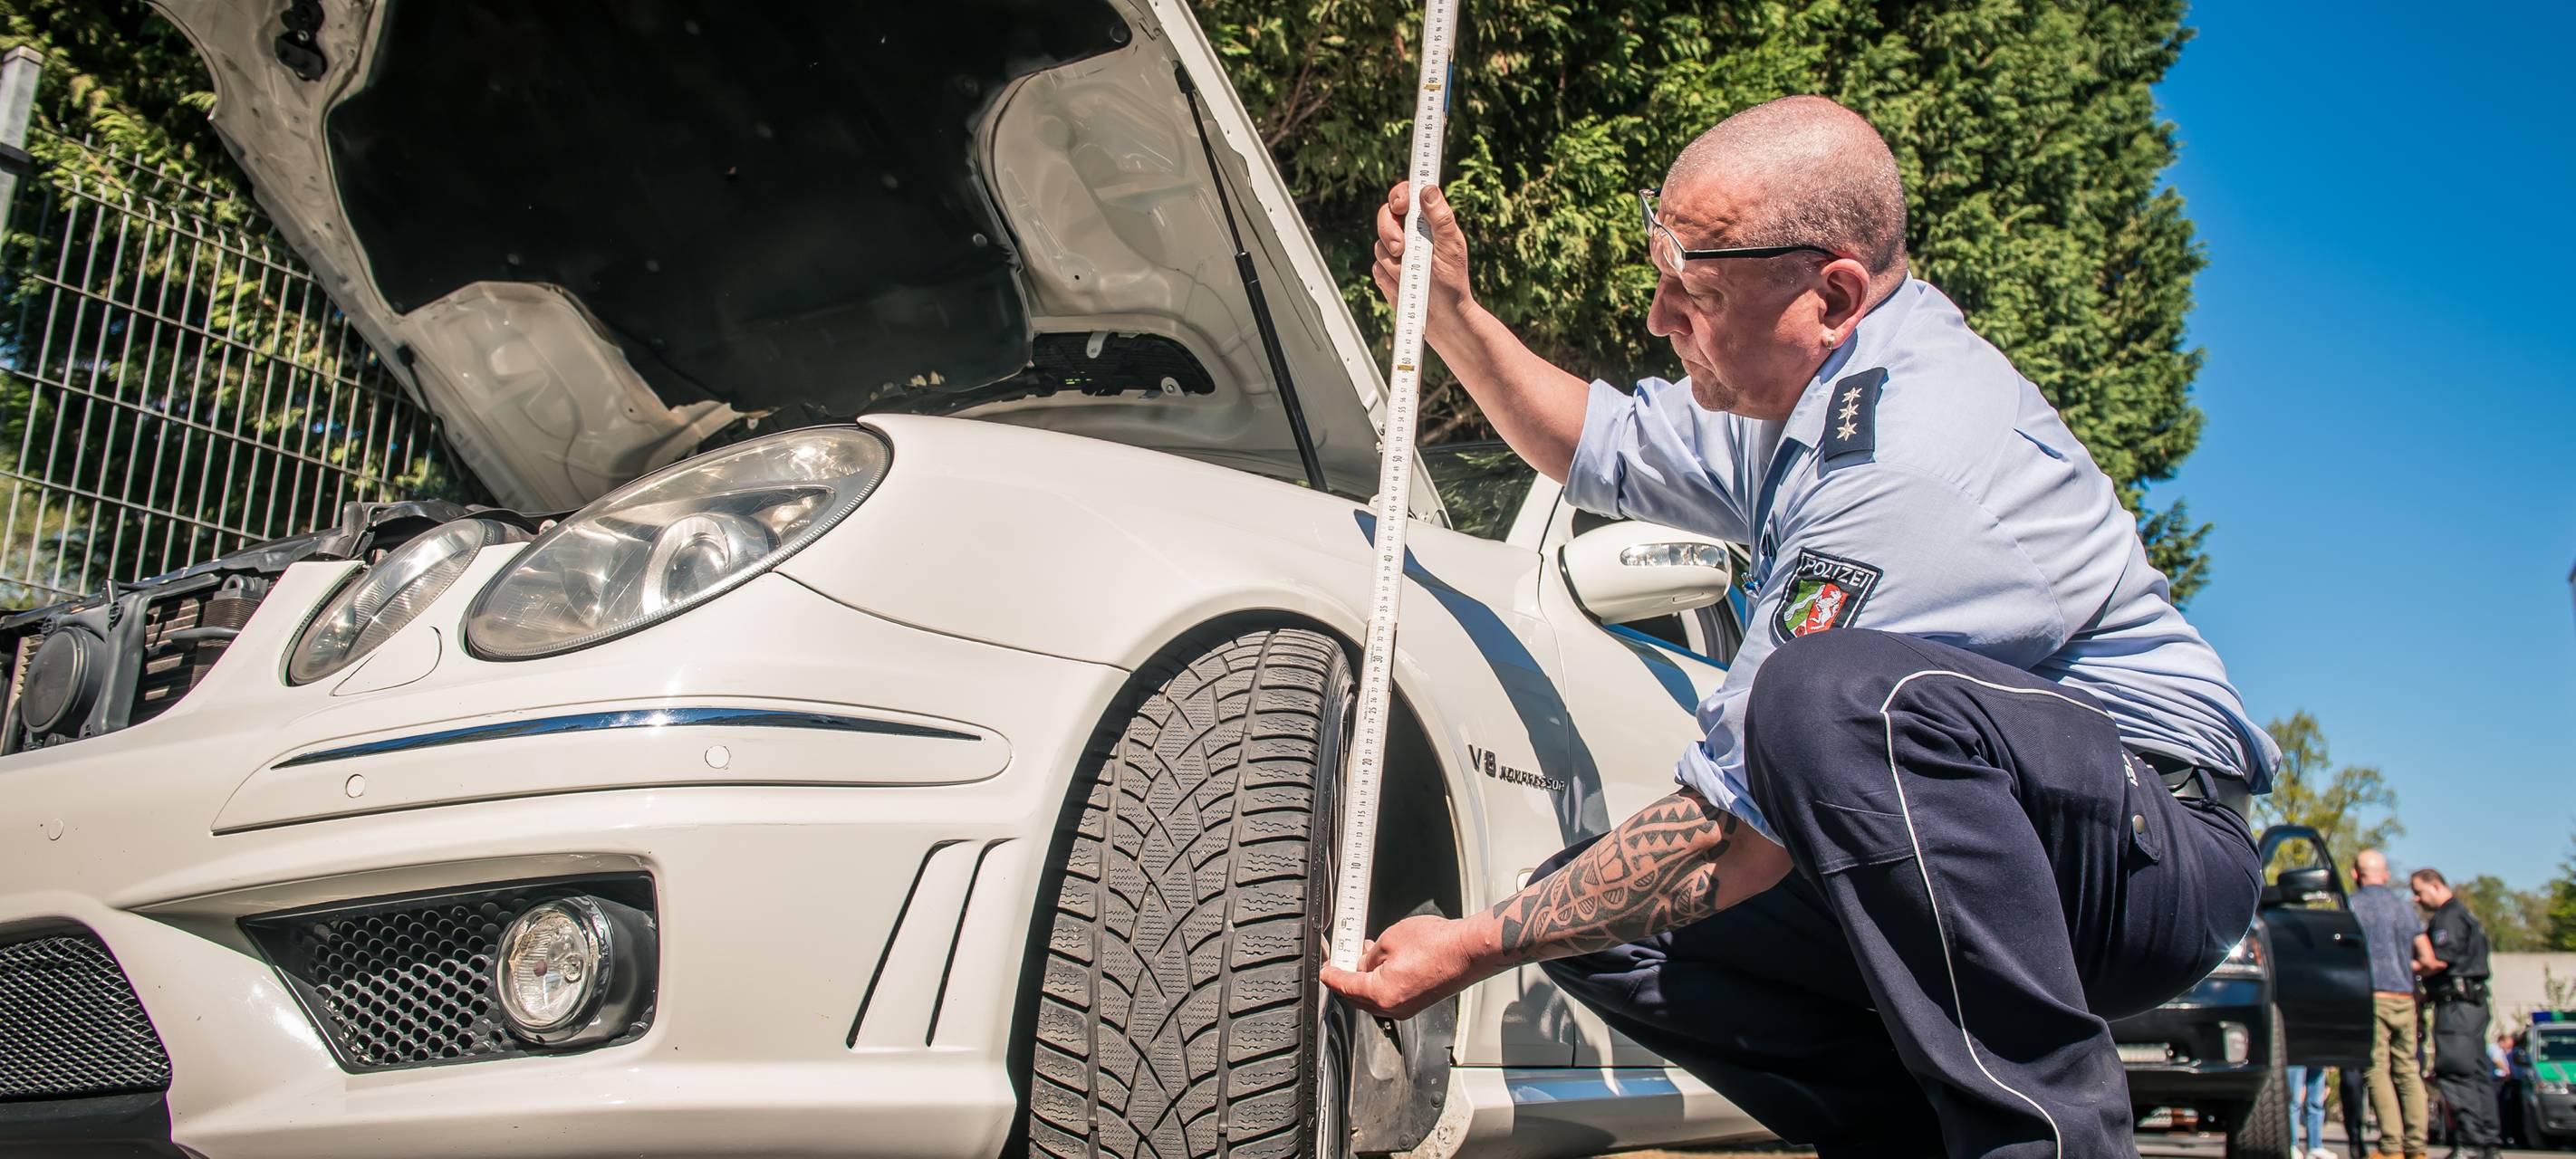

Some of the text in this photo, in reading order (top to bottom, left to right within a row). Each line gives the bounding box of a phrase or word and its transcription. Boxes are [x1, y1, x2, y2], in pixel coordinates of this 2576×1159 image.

[1802, 559, 1869, 589] POLIZEI
[1362, 758, 1372, 766] 20
[1373, 655, 1382, 663] 30
[1379, 605, 1388, 613] 35
[1467, 743, 1496, 778] V8
